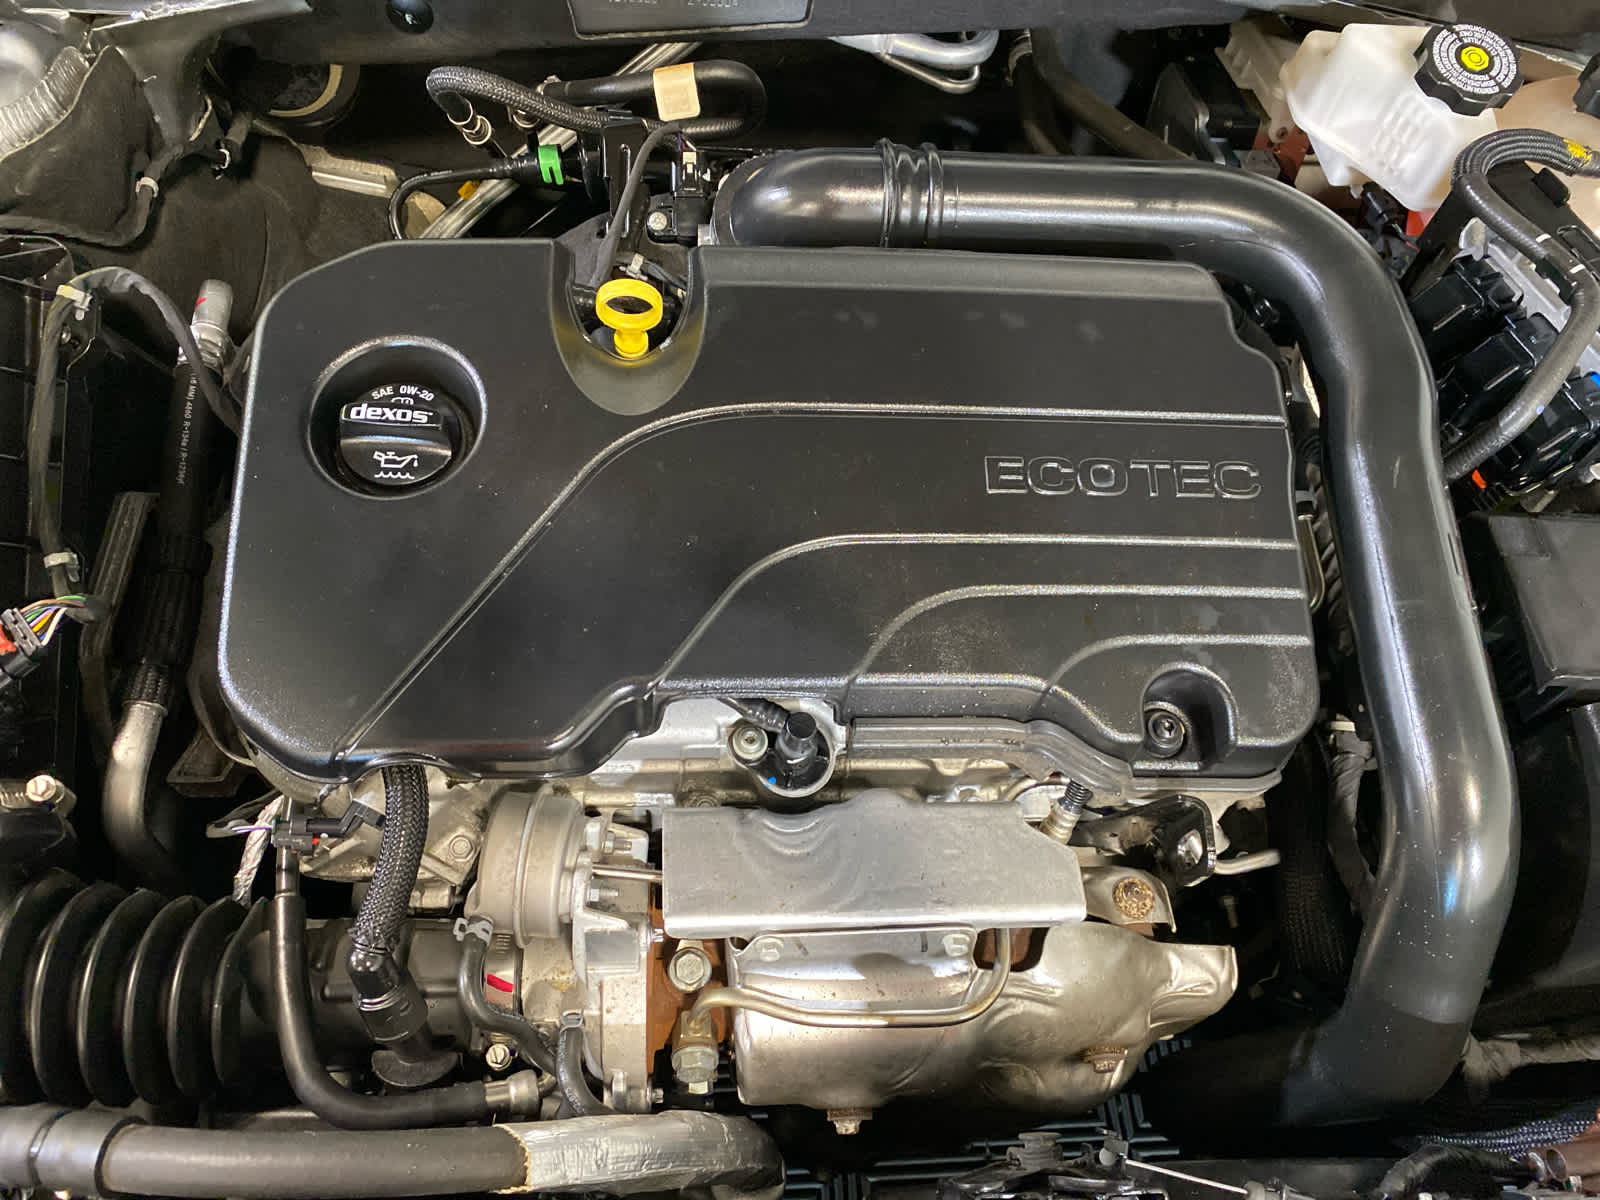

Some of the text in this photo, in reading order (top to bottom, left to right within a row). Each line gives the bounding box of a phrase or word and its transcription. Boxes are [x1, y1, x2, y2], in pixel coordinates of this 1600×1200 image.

[371, 385, 434, 401] SAE 0W-20
[350, 403, 429, 423] dexos
[985, 456, 1261, 499] ECOTEC
